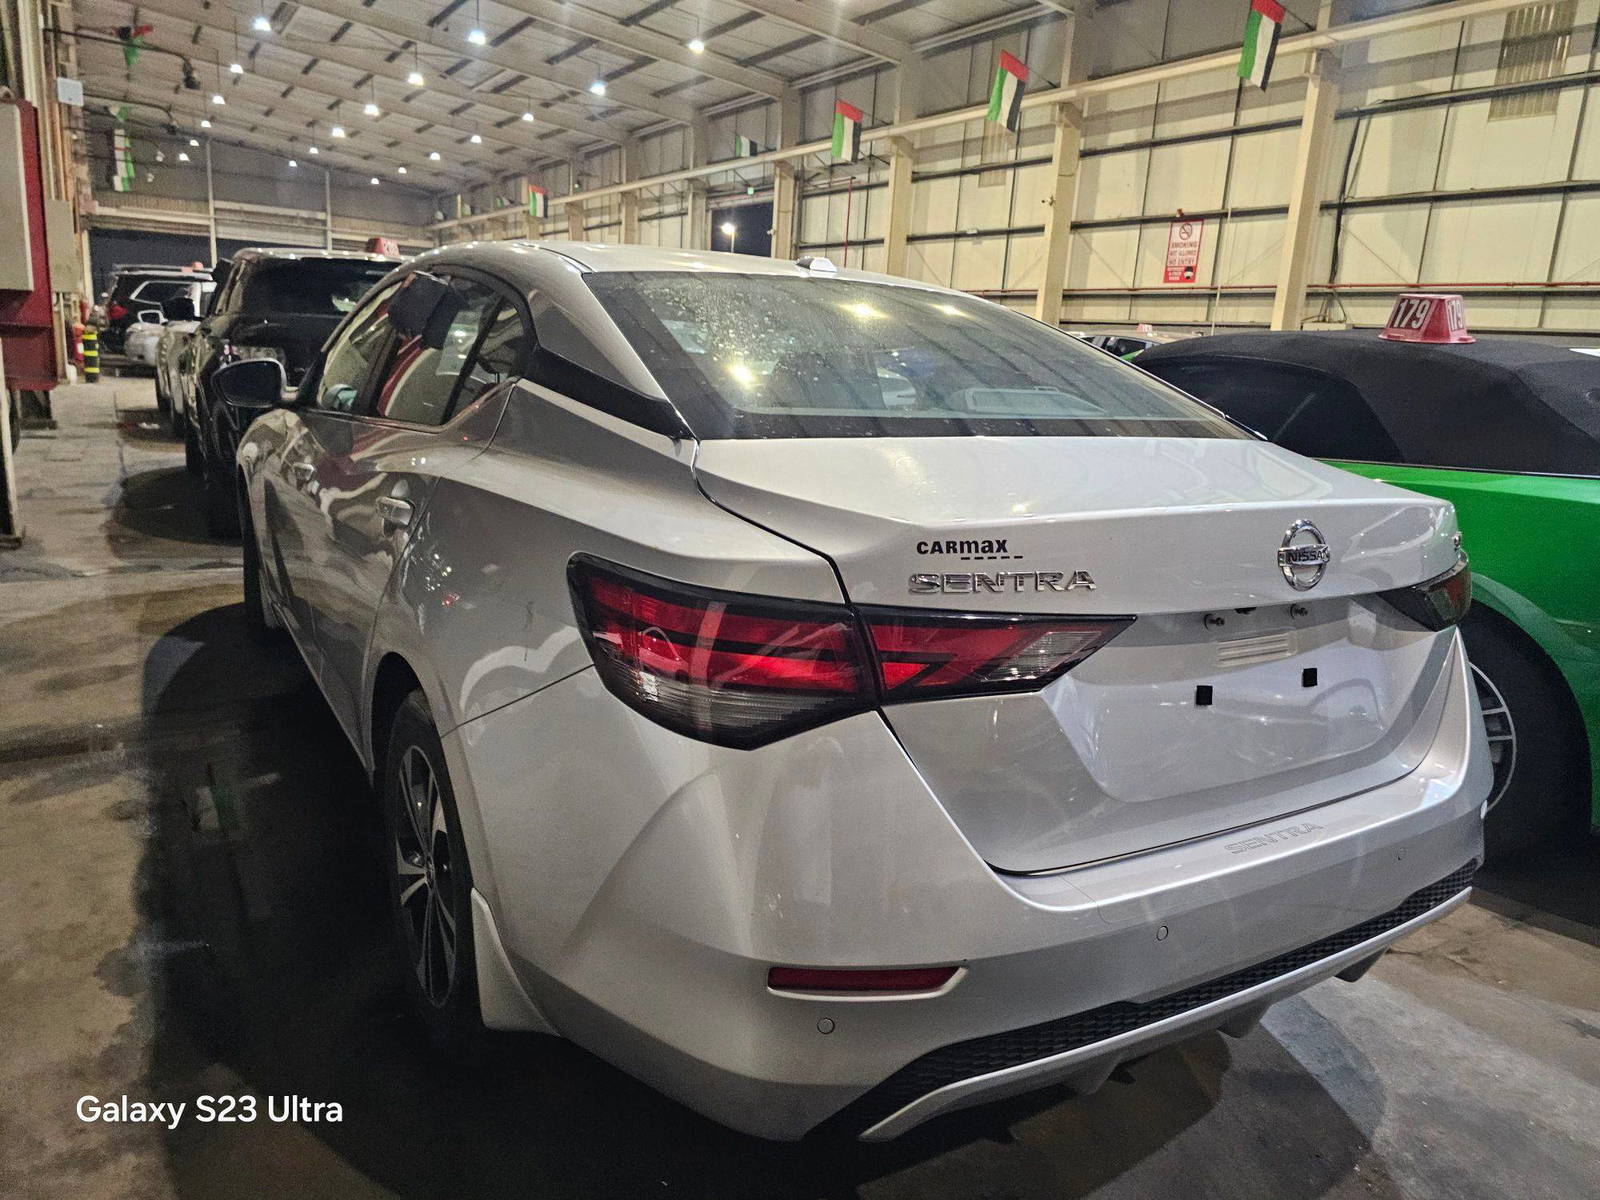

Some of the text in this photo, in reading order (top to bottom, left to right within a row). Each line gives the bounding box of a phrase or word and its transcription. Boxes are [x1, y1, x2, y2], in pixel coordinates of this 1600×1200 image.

[1393, 299, 1431, 329] 179
[1447, 300, 1463, 331] 179
[1287, 550, 1328, 562] NISSAN
[908, 569, 1097, 594] SENTRA
[1224, 823, 1324, 855] SENTRA
